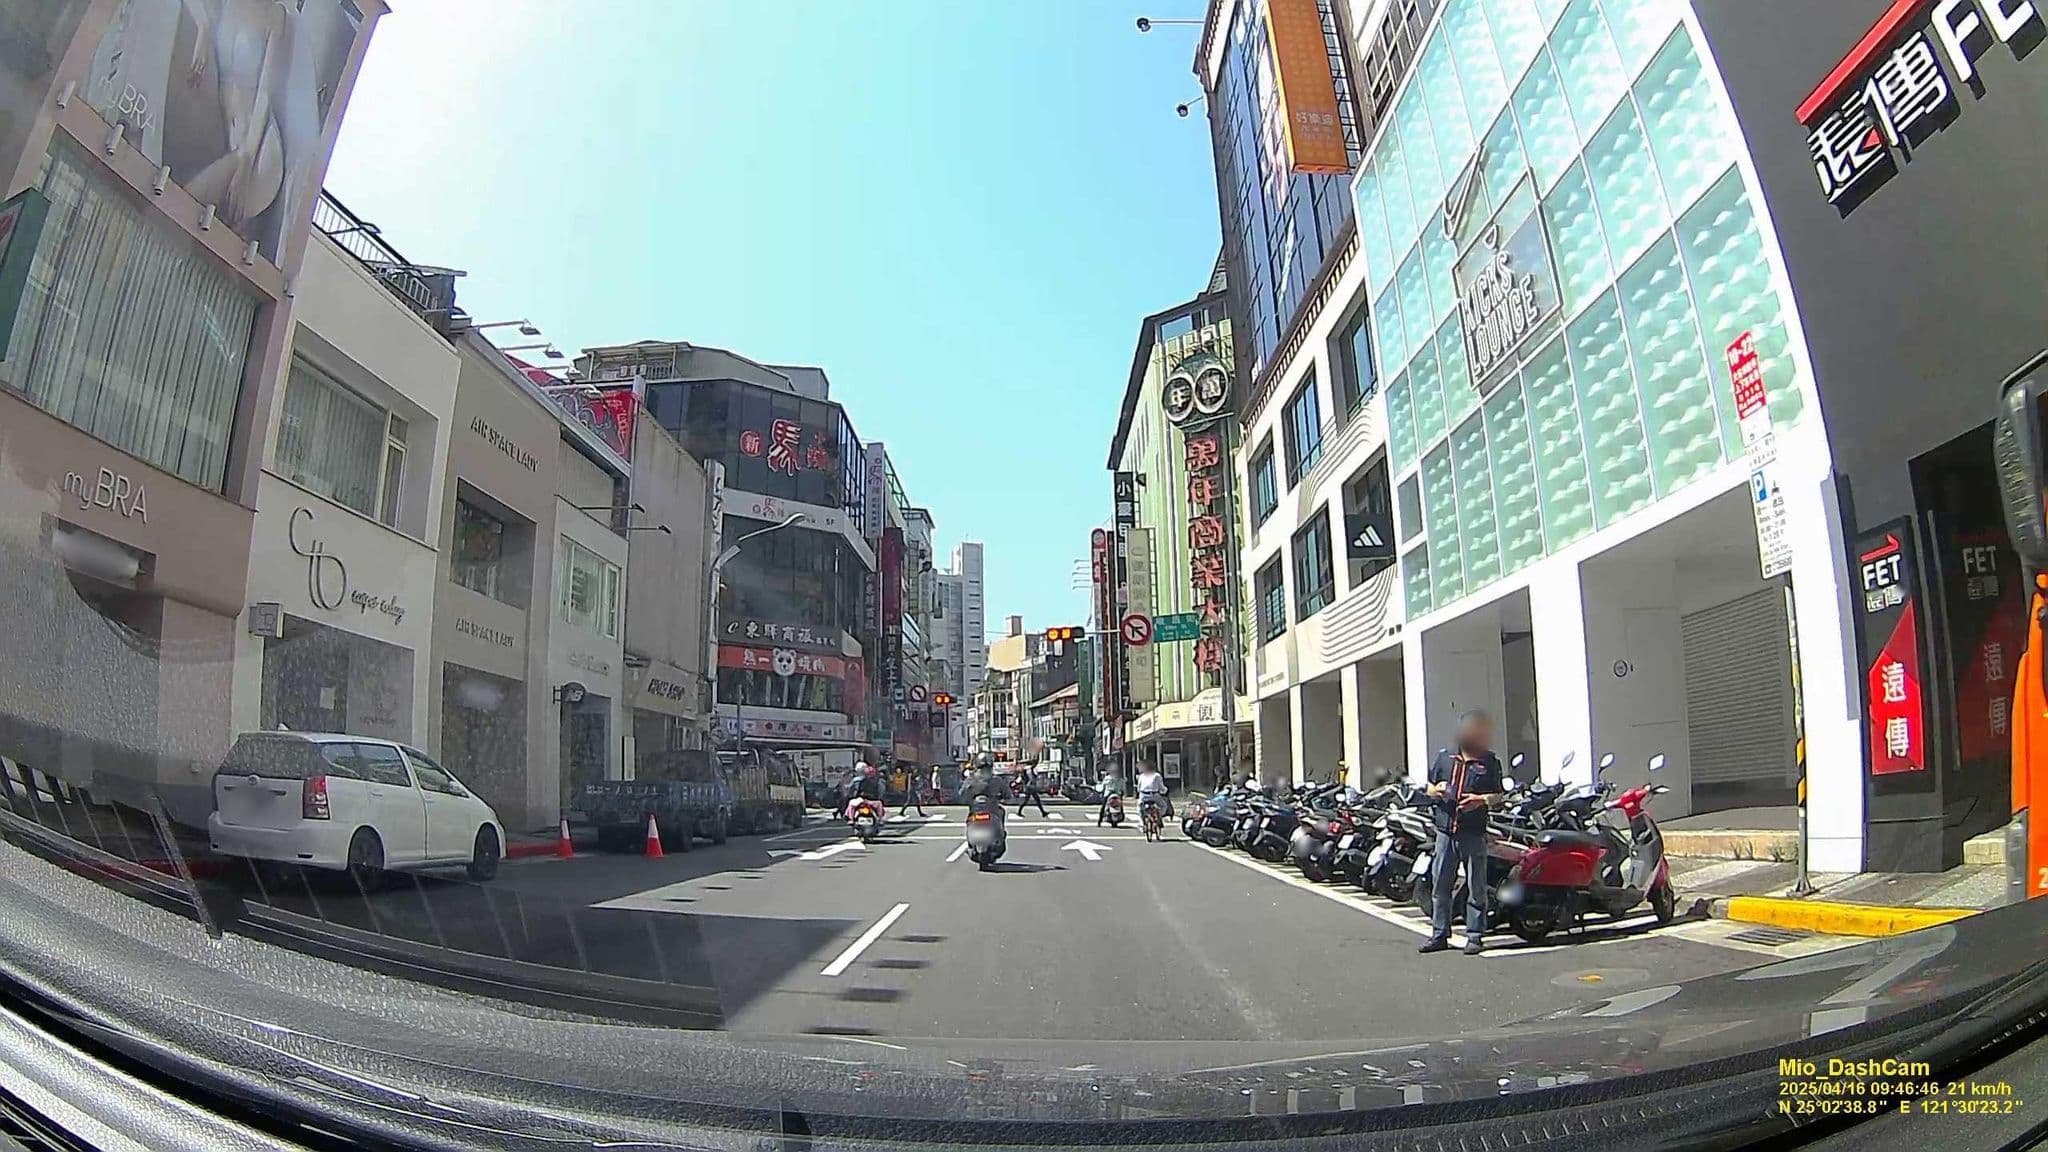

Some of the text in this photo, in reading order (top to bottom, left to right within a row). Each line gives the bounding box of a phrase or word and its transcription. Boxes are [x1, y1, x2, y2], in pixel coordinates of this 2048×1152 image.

[1461, 250, 1513, 337] KICKS
[1466, 272, 1538, 379] LOUNGE
[64, 467, 148, 524] myBRA
[1862, 555, 1901, 591] FET
[1962, 545, 1998, 574] FET
[1883, 661, 1908, 759] 遠傳
